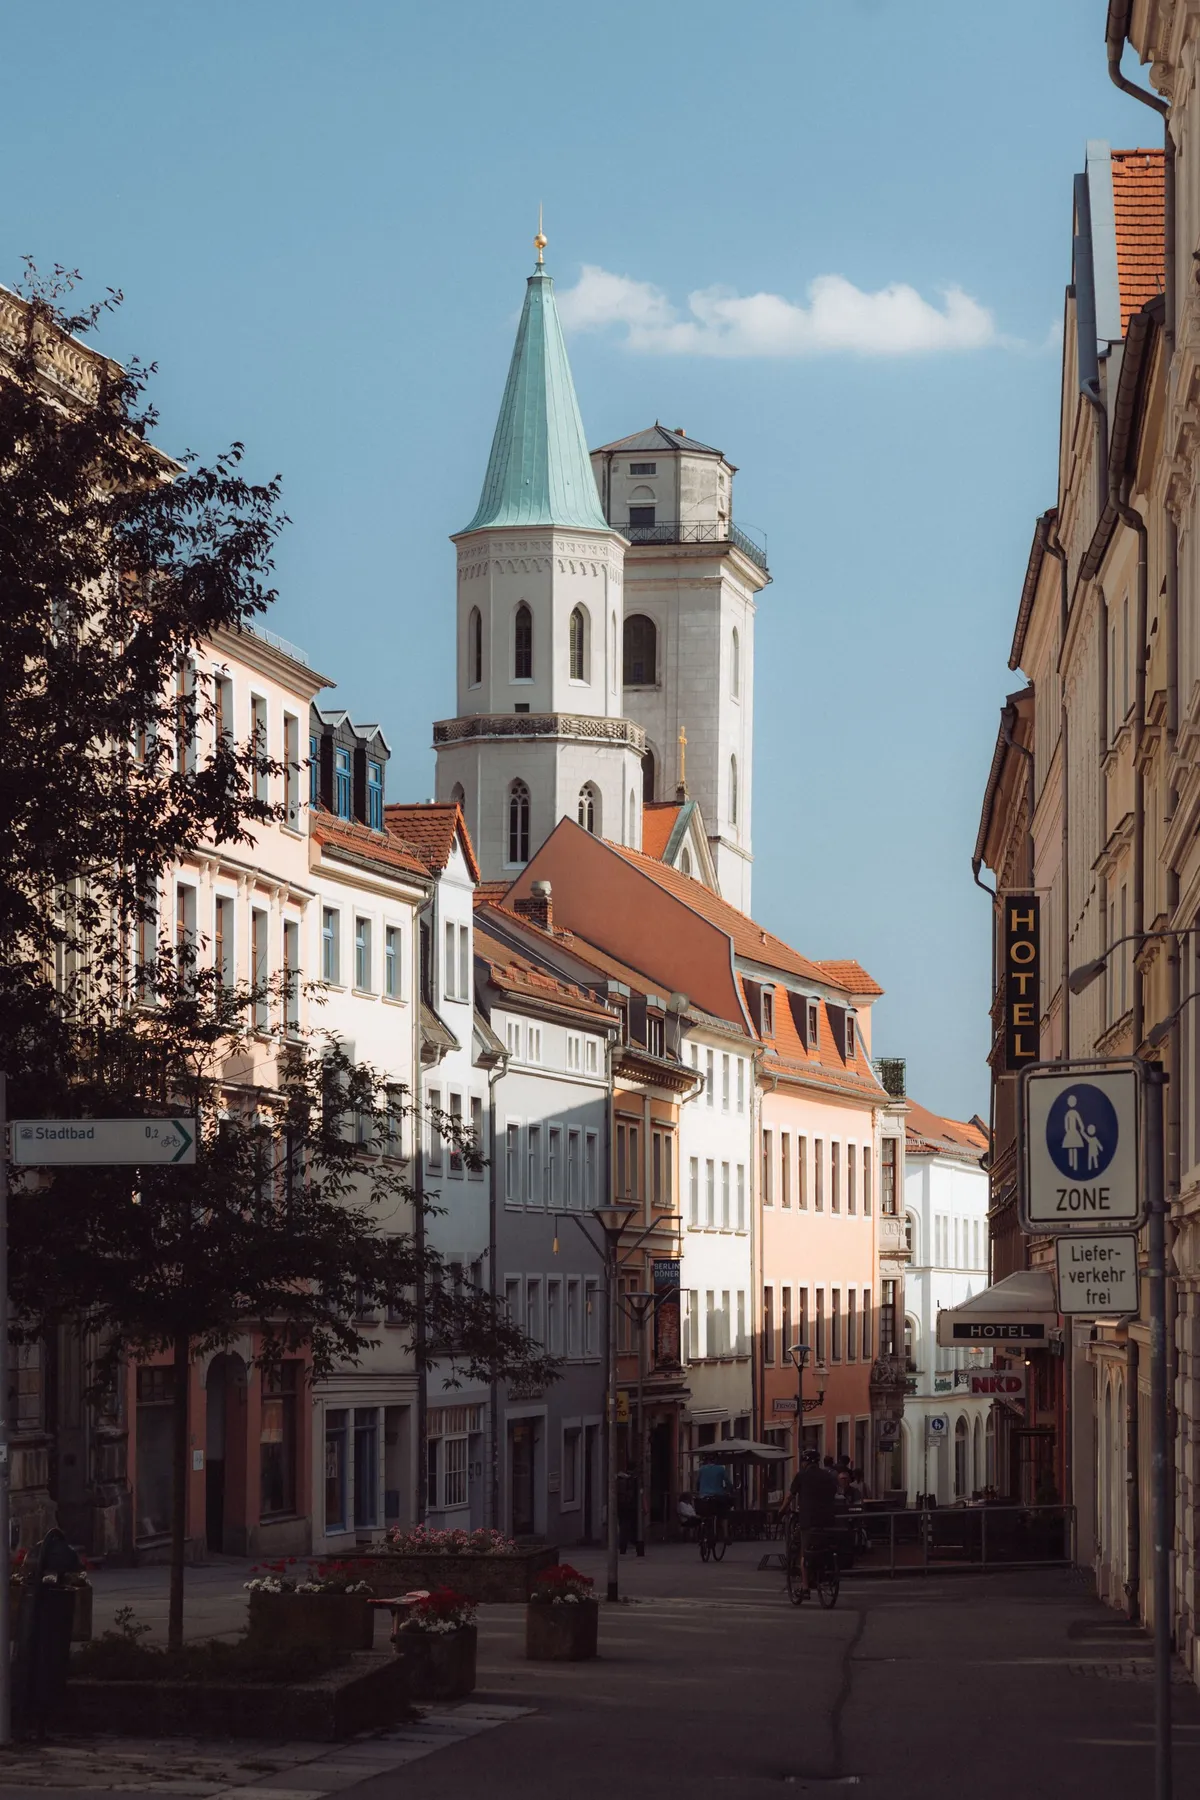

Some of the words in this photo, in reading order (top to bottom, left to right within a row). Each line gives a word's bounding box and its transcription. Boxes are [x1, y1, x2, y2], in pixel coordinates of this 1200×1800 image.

[1010, 909, 1036, 1057] HOTEL
[35, 1127, 95, 1140] Stadtbad
[145, 1126, 159, 1139] 0,2
[1056, 1188, 1111, 1212] ZONE
[1071, 1245, 1122, 1262] Liefer-
[654, 1262, 680, 1270] BERLIN
[654, 1269, 680, 1278] DÖNER
[1068, 1266, 1126, 1283] verkehr
[1086, 1287, 1112, 1306] frei
[969, 1325, 1031, 1338] HOTEL
[971, 1376, 1022, 1394] NKD
